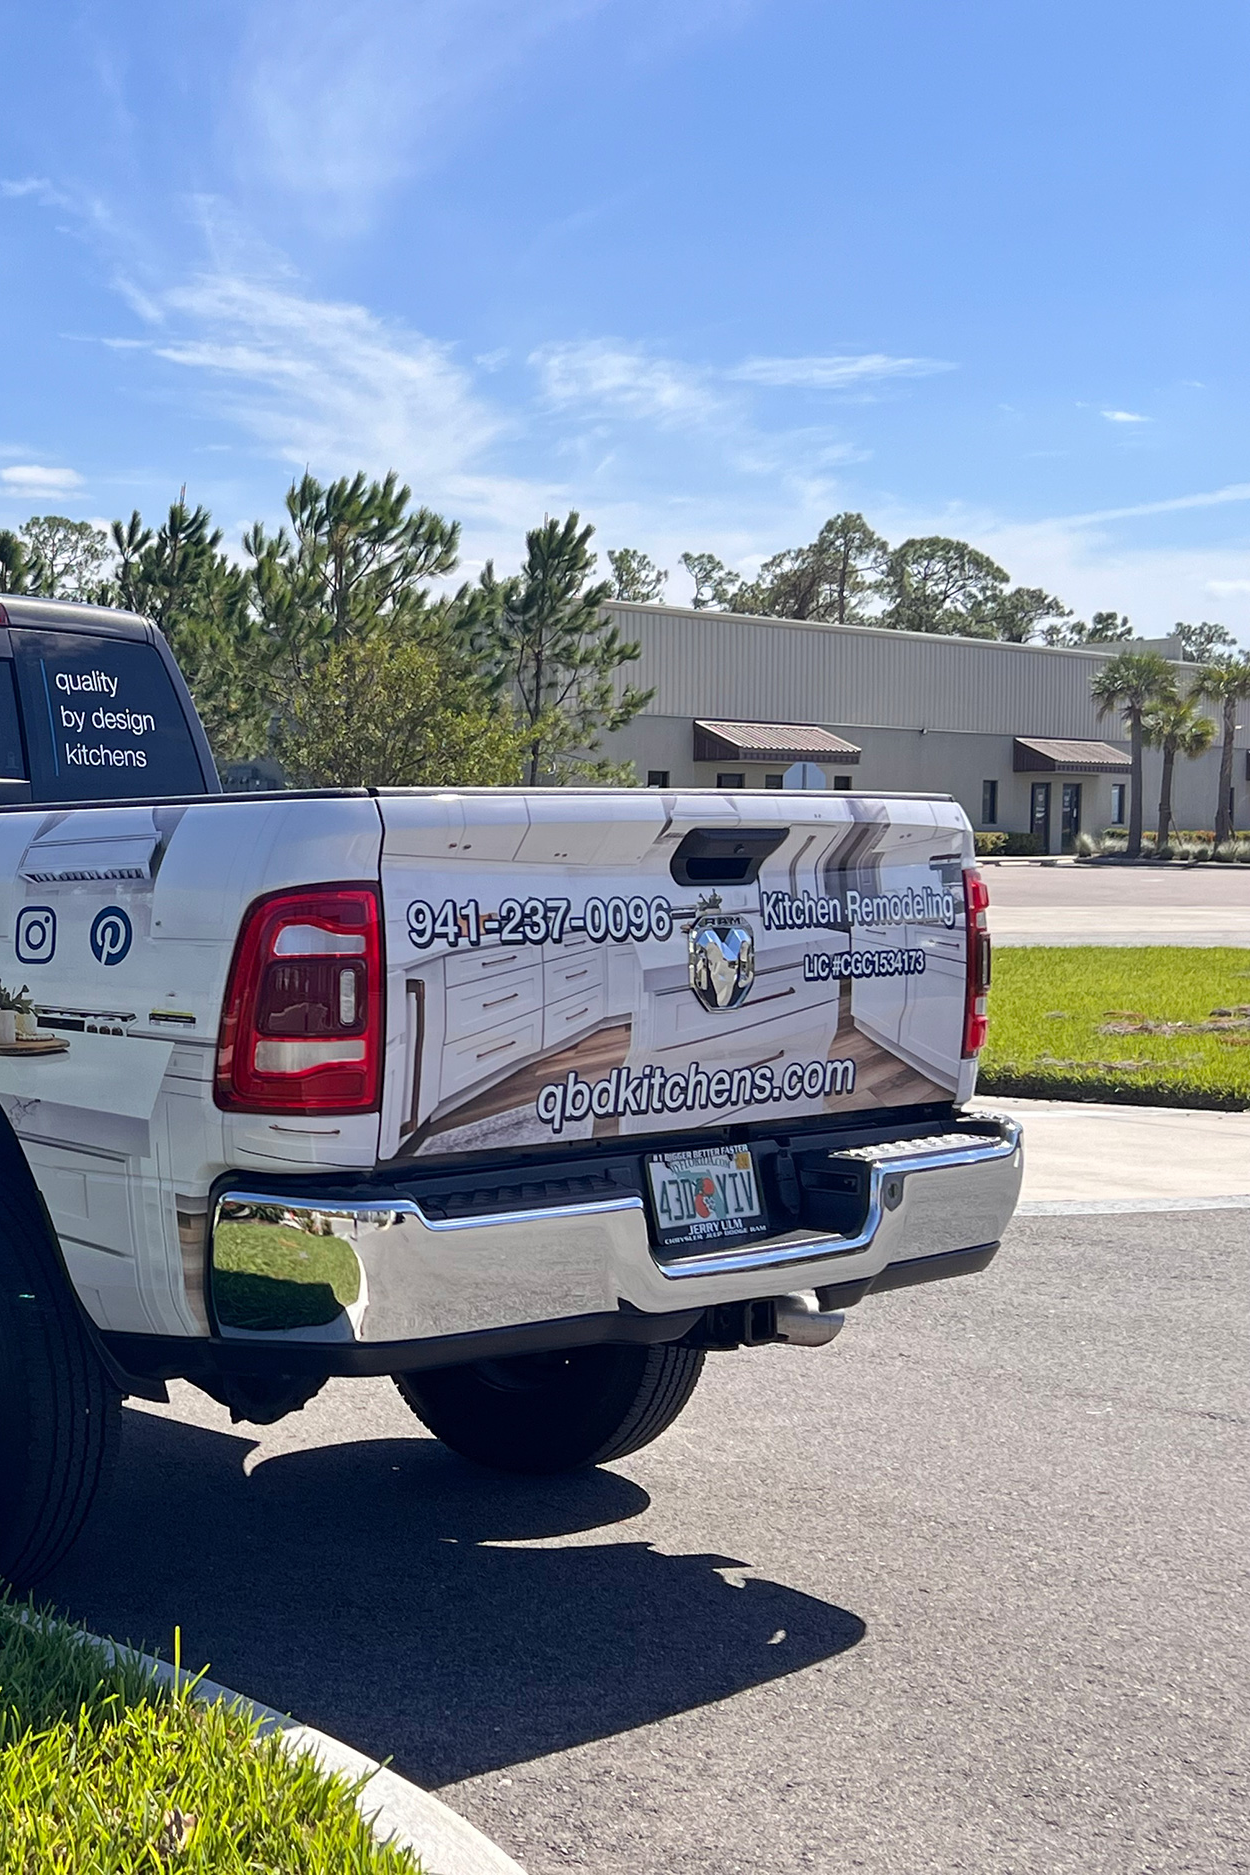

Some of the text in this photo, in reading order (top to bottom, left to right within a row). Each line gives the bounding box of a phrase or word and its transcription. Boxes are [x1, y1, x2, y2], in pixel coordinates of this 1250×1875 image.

[55, 671, 117, 698] quality
[60, 706, 155, 735] by design
[66, 743, 147, 768] kitchens
[704, 916, 742, 926] RAM
[762, 885, 956, 930] Kitchen Remodeling
[408, 895, 673, 948] 941-237-0096
[804, 949, 926, 982] LIC #CGC1534173
[537, 1058, 856, 1132] qbdkitchens.com
[664, 1151, 692, 1162] BIGGER
[693, 1148, 720, 1160] BETTER
[721, 1144, 748, 1155] FASTER
[664, 1225, 767, 1245] CHRYSLER JEEP DODGE RAM
[689, 1218, 743, 1235] JERRY ULM
